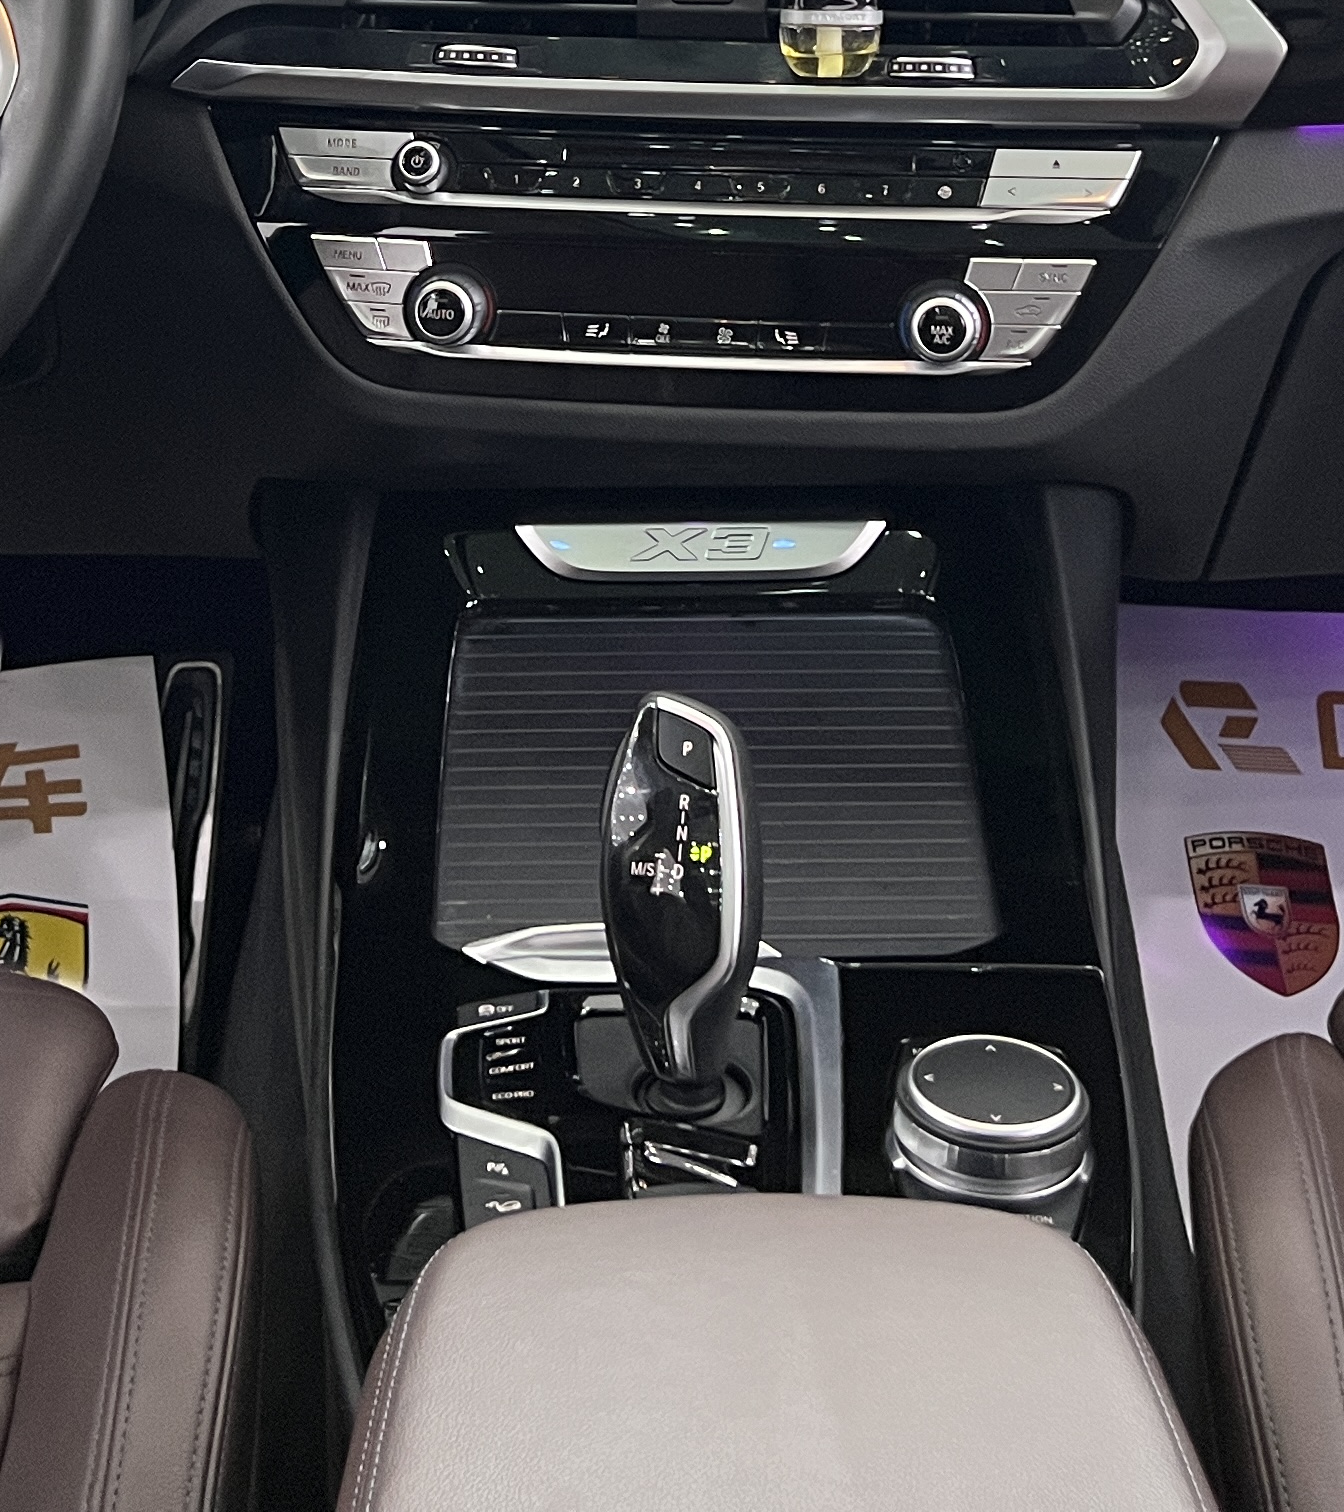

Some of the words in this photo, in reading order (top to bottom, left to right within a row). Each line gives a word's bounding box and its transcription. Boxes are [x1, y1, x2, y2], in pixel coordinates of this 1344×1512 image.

[327, 137, 357, 150] MODE
[332, 165, 360, 177] BAND
[333, 249, 363, 261] MENU
[346, 281, 371, 293] MAX
[427, 308, 454, 321] AUTO
[930, 325, 954, 336] MAX
[933, 334, 952, 346] A/C
[630, 526, 771, 562] X3
[682, 740, 693, 756] P
[679, 794, 690, 810] R
[676, 825, 688, 841] N
[1191, 835, 1324, 859] PORSCHE
[630, 861, 655, 876] M/S
[673, 863, 684, 879] D
[495, 1036, 526, 1046] SPORT
[489, 1061, 534, 1075] COMFORT
[492, 1091, 512, 1100] ECO
[514, 1090, 534, 1099] PRO
[1022, 1214, 1053, 1225] TION
